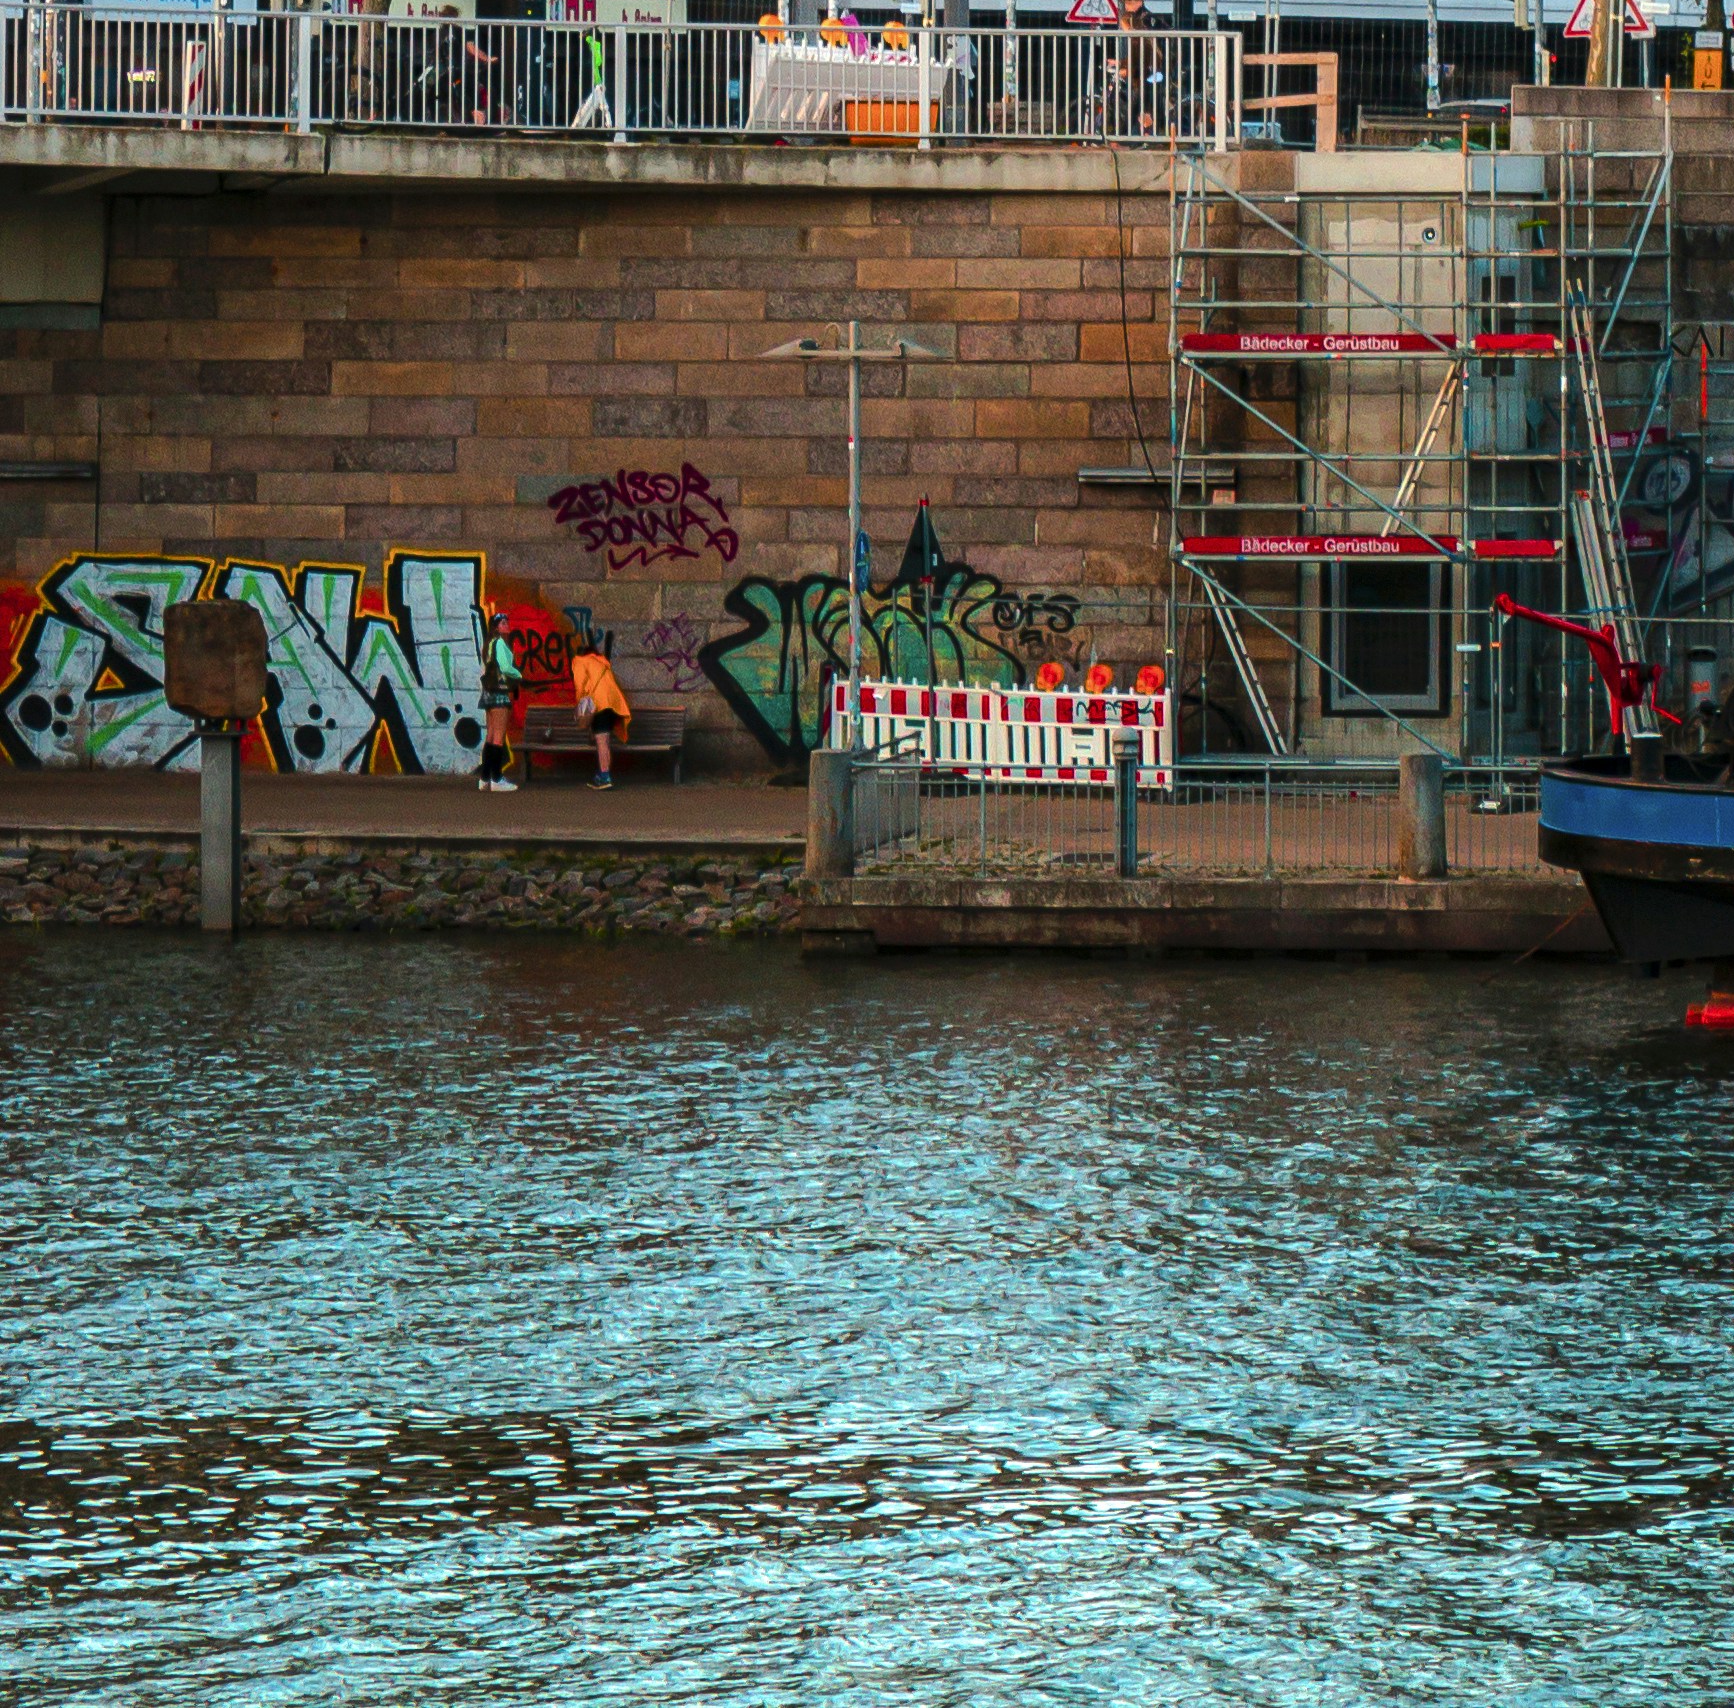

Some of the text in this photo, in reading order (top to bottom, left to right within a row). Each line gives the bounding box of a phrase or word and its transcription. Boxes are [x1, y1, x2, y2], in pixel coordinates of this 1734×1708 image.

[1240, 336, 1309, 350] Bädecker
[1323, 336, 1399, 350] Gerüstbau
[1241, 540, 1310, 553] Bädecker
[1324, 540, 1400, 553] Gerüstbau
